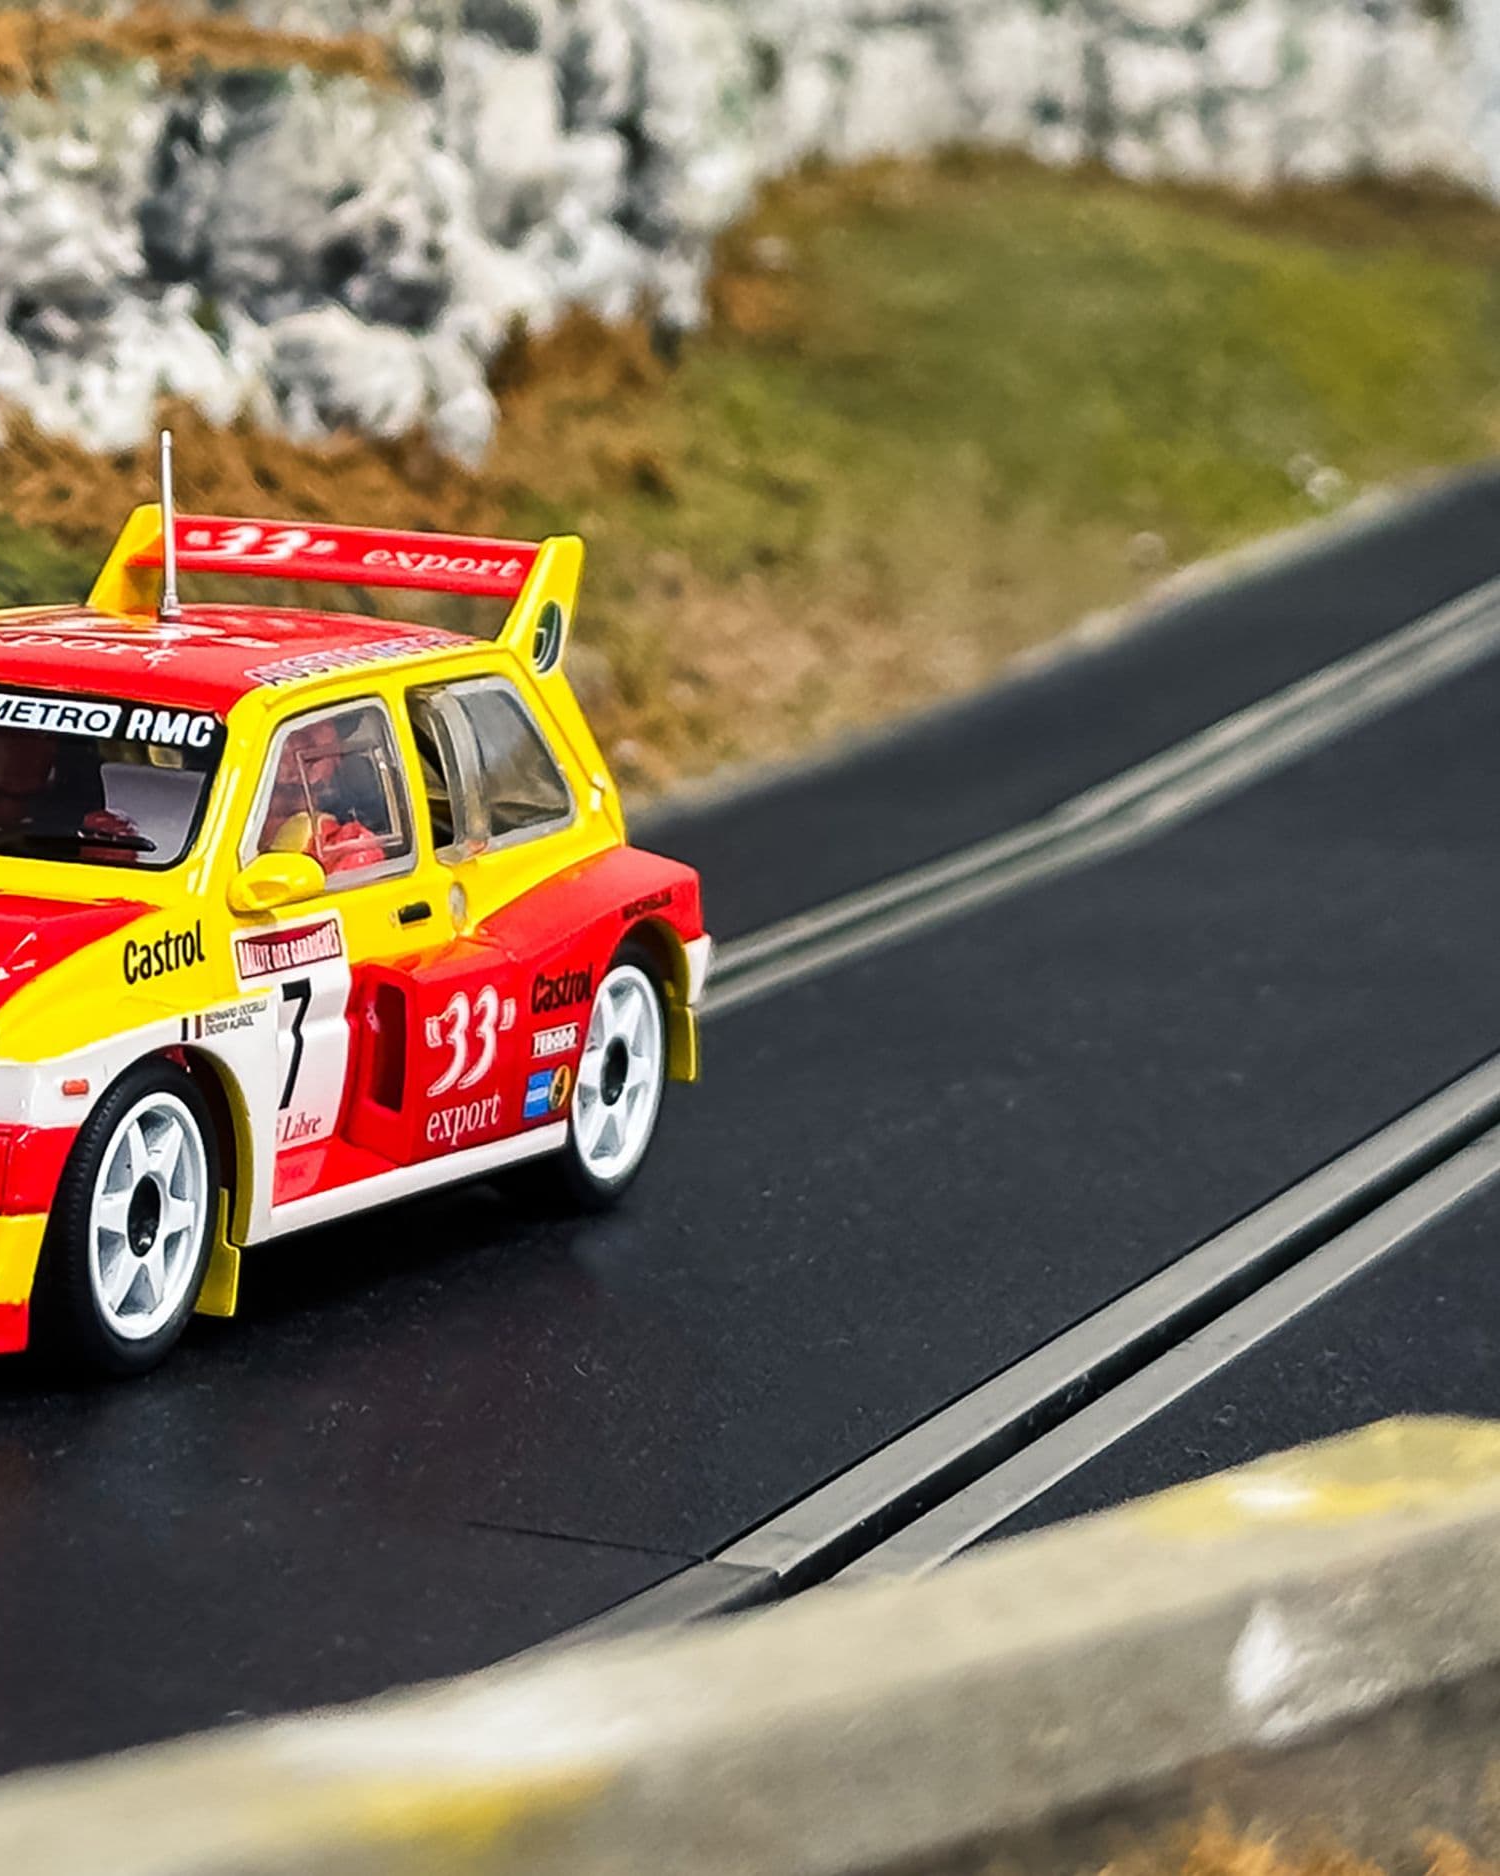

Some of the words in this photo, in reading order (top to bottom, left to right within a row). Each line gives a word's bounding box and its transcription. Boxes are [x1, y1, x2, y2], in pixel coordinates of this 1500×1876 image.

[362, 547, 523, 579] export
[126, 709, 215, 748] RMC
[124, 920, 205, 985] Castrol
[531, 963, 593, 1014] Castrol
[279, 977, 312, 1111] 7
[426, 1090, 502, 1146] export
